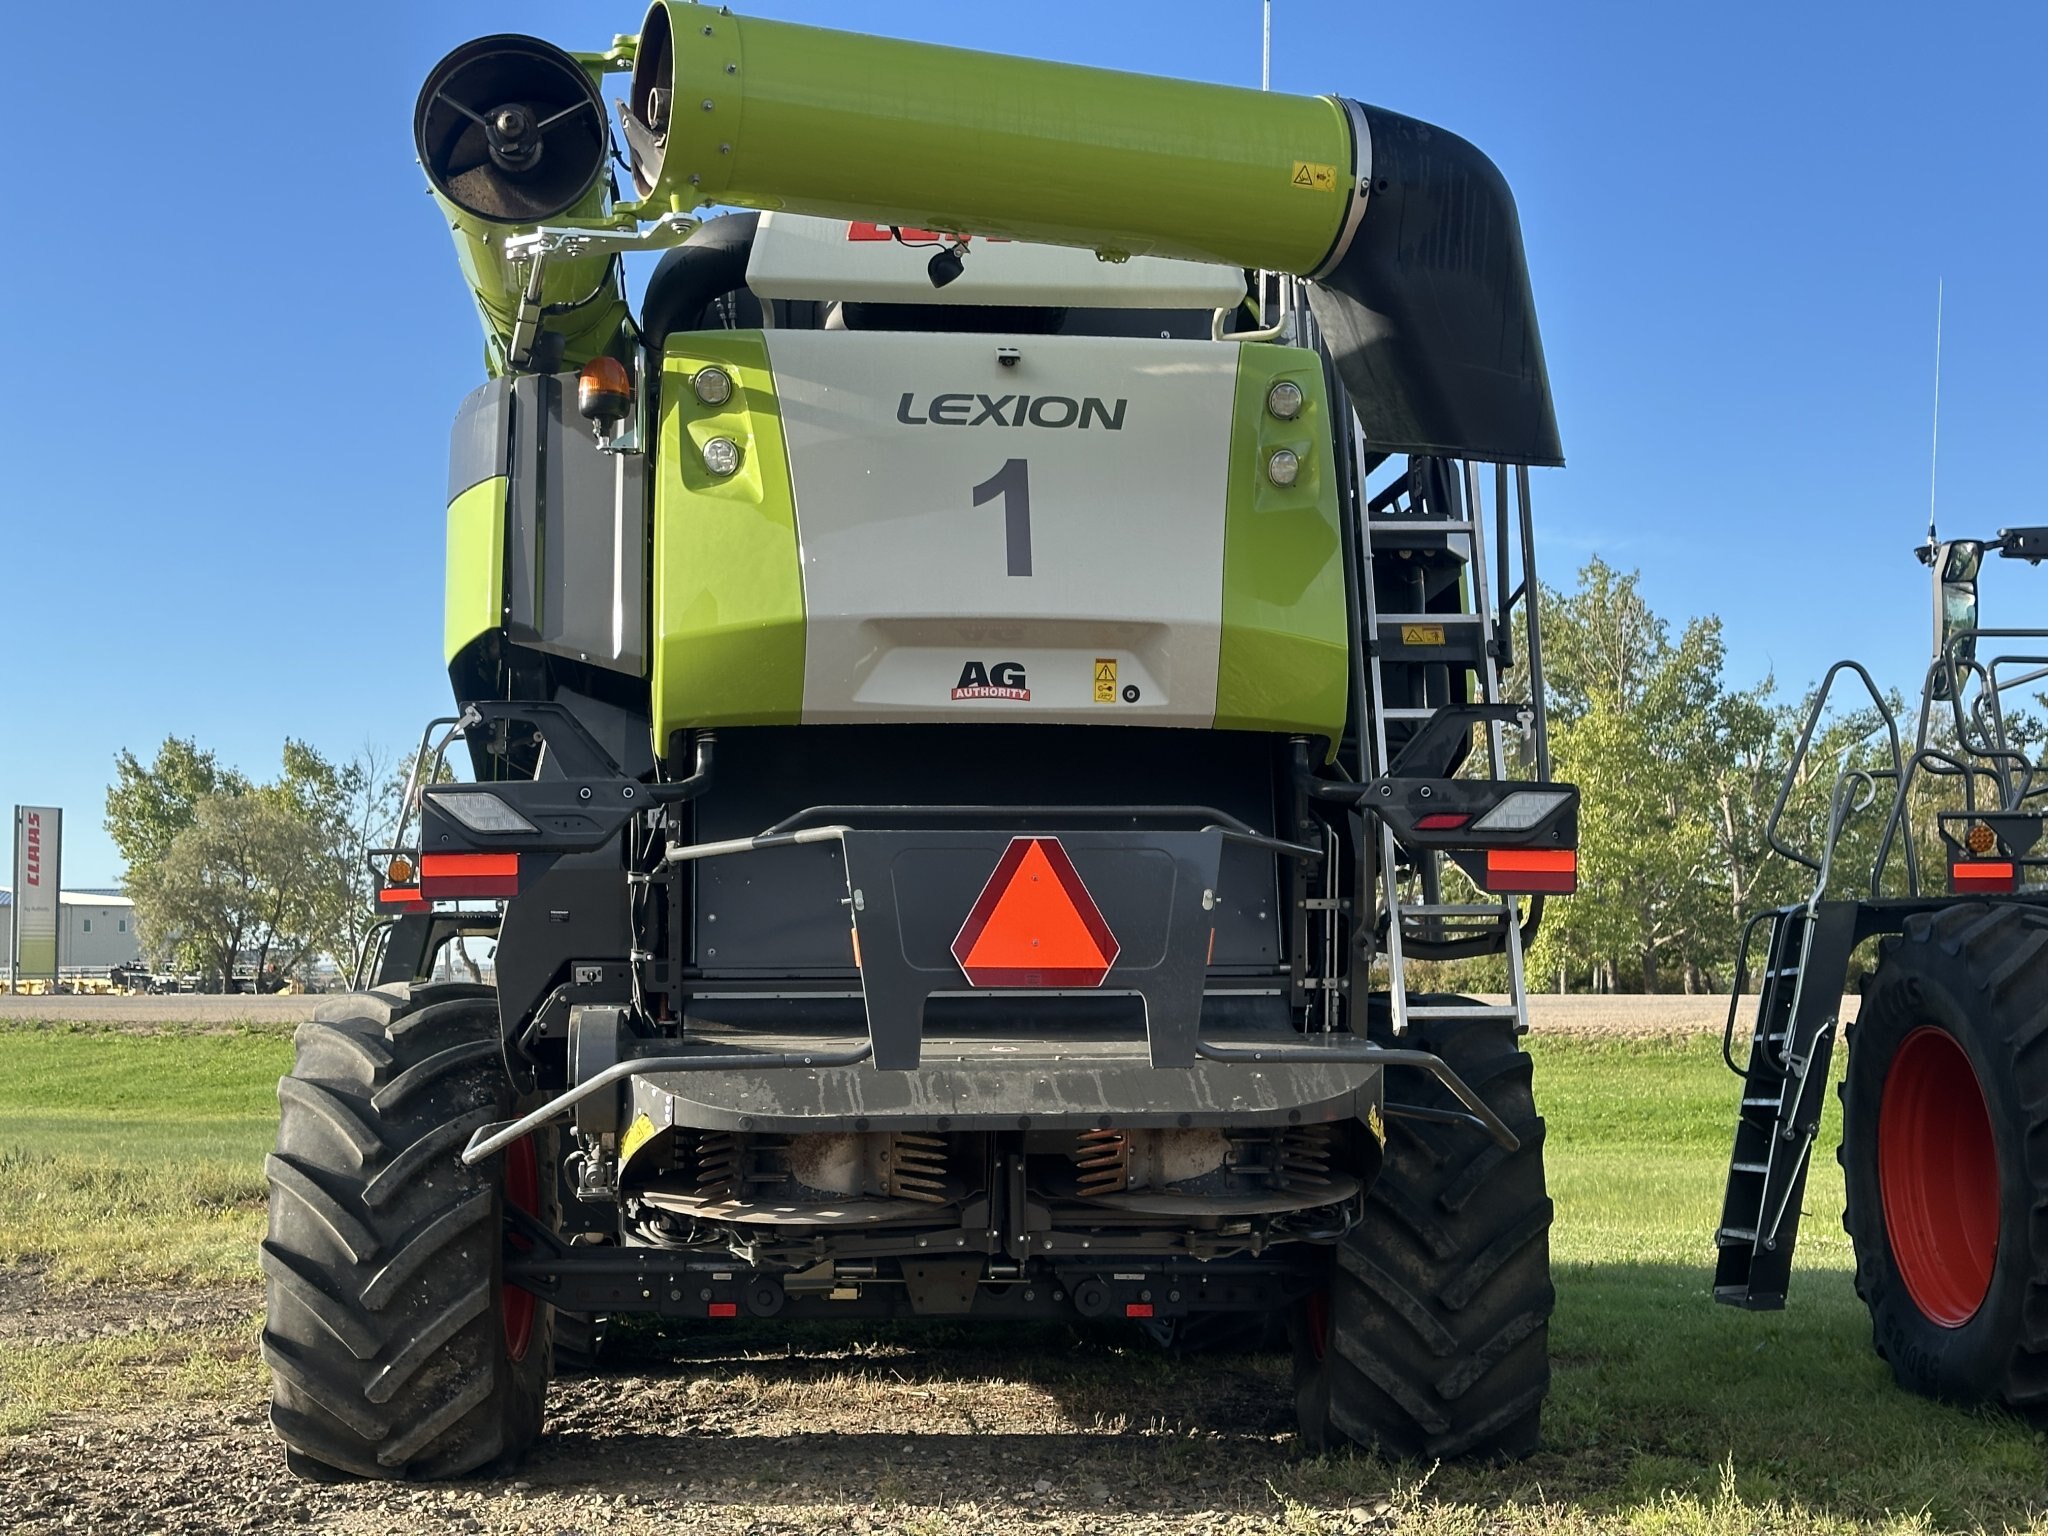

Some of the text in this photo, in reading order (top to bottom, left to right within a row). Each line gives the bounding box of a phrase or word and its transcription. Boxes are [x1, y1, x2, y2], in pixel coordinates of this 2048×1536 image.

[896, 392, 1128, 430] LEXION
[972, 458, 1032, 577] 1
[955, 687, 1027, 699] AUTHORITY
[956, 661, 1026, 690] AG
[28, 812, 40, 887] CLAAS
